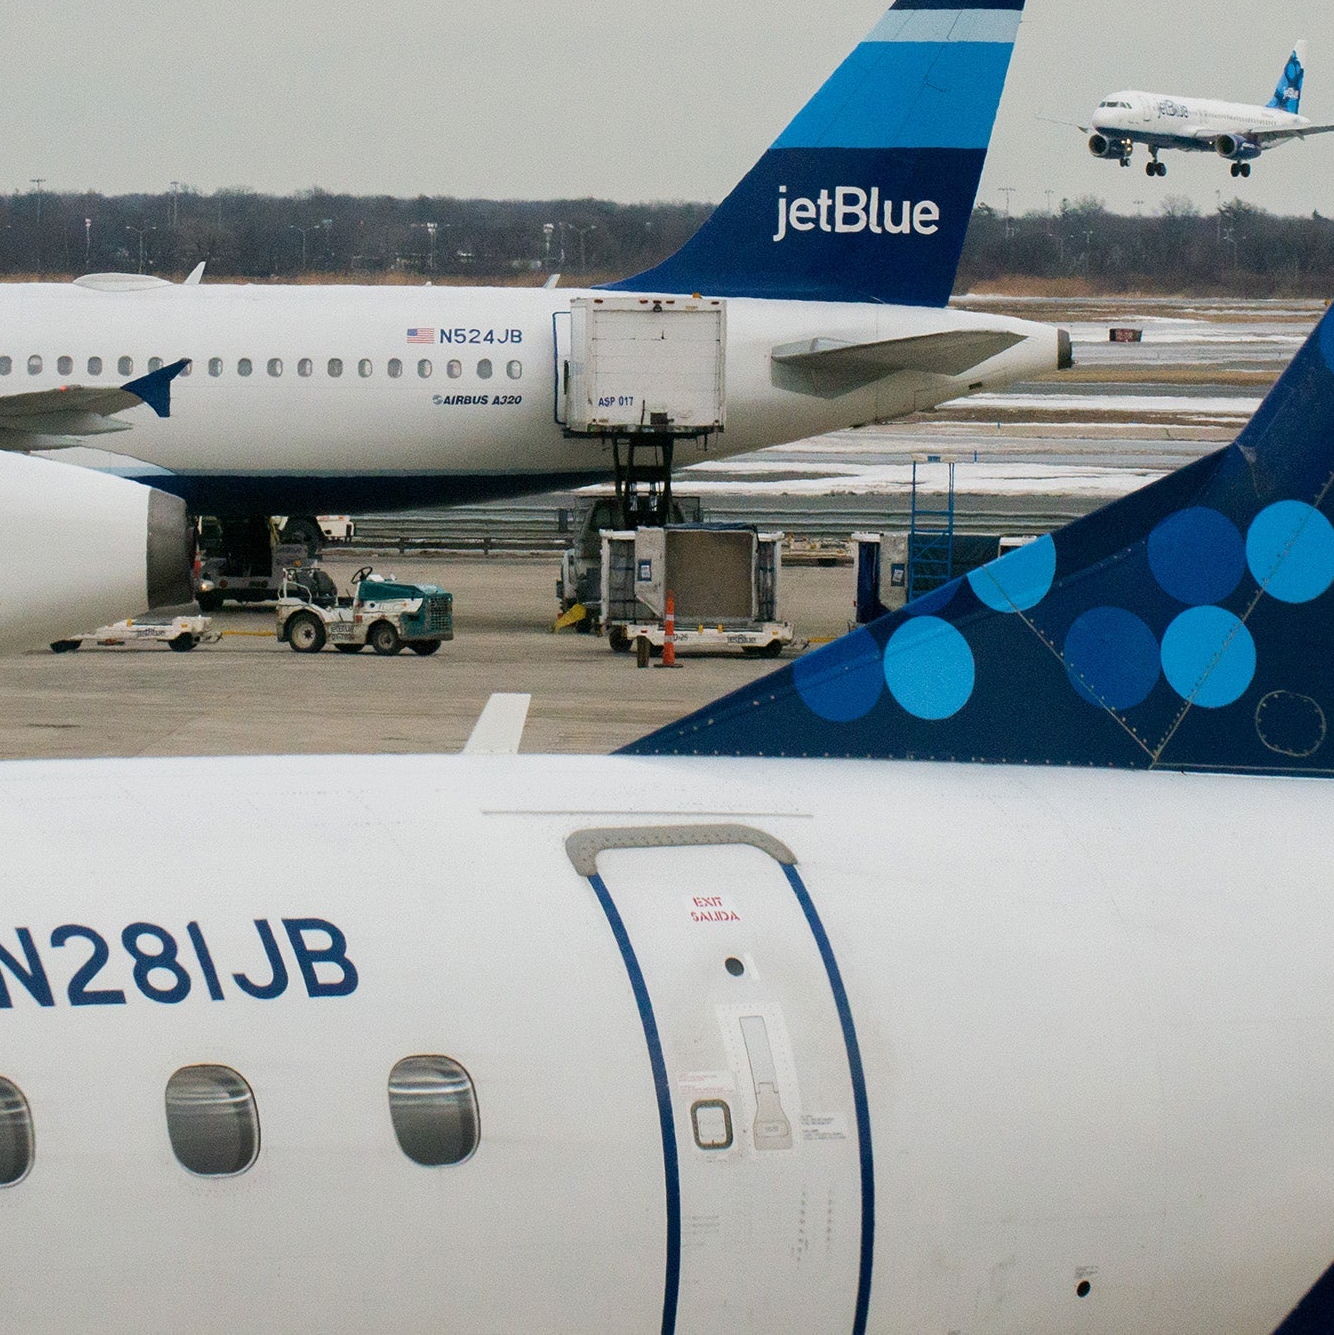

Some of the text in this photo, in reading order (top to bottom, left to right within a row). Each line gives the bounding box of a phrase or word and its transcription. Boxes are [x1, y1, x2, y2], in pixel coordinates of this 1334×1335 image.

[773, 185, 940, 242] jetBlue
[439, 328, 523, 344] N524JB
[443, 395, 523, 405] AIRBUS A320
[598, 395, 634, 407] ASP 017
[692, 896, 723, 907] EXIT
[690, 910, 741, 922] SALIDA
